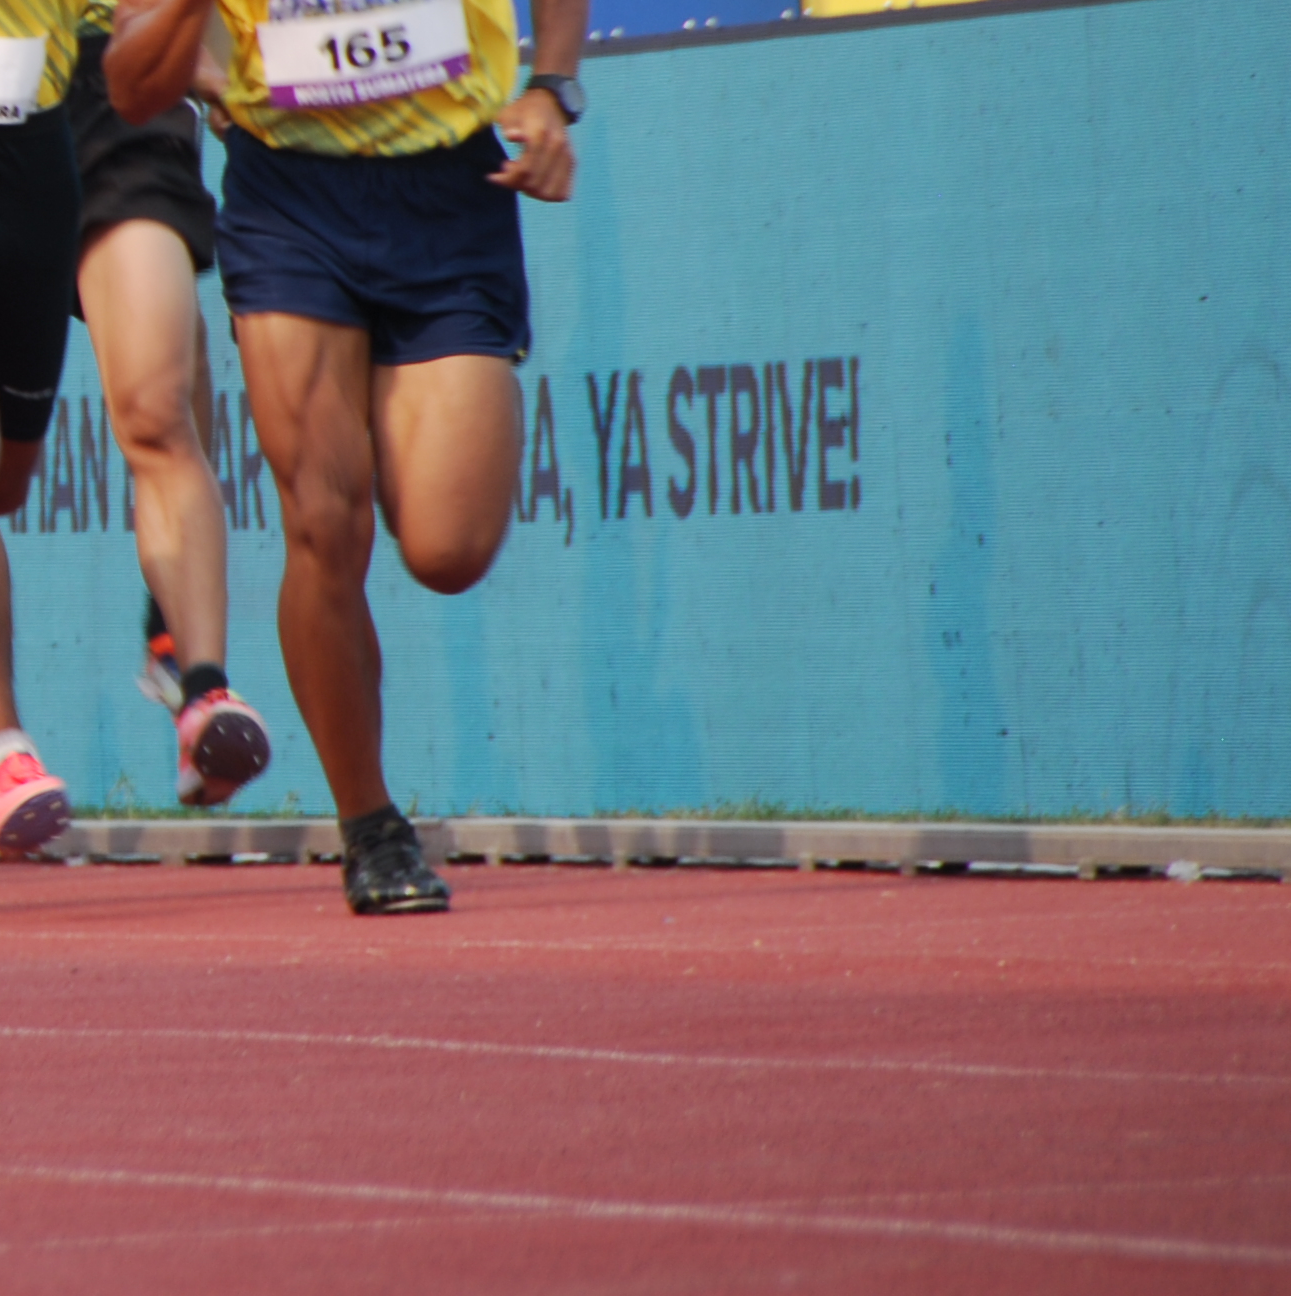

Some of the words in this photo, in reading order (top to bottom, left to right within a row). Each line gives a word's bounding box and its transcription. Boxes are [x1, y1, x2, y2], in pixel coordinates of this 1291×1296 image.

[320, 25, 410, 70] 165
[586, 369, 654, 521] YA
[667, 356, 862, 521] STRIVE!
